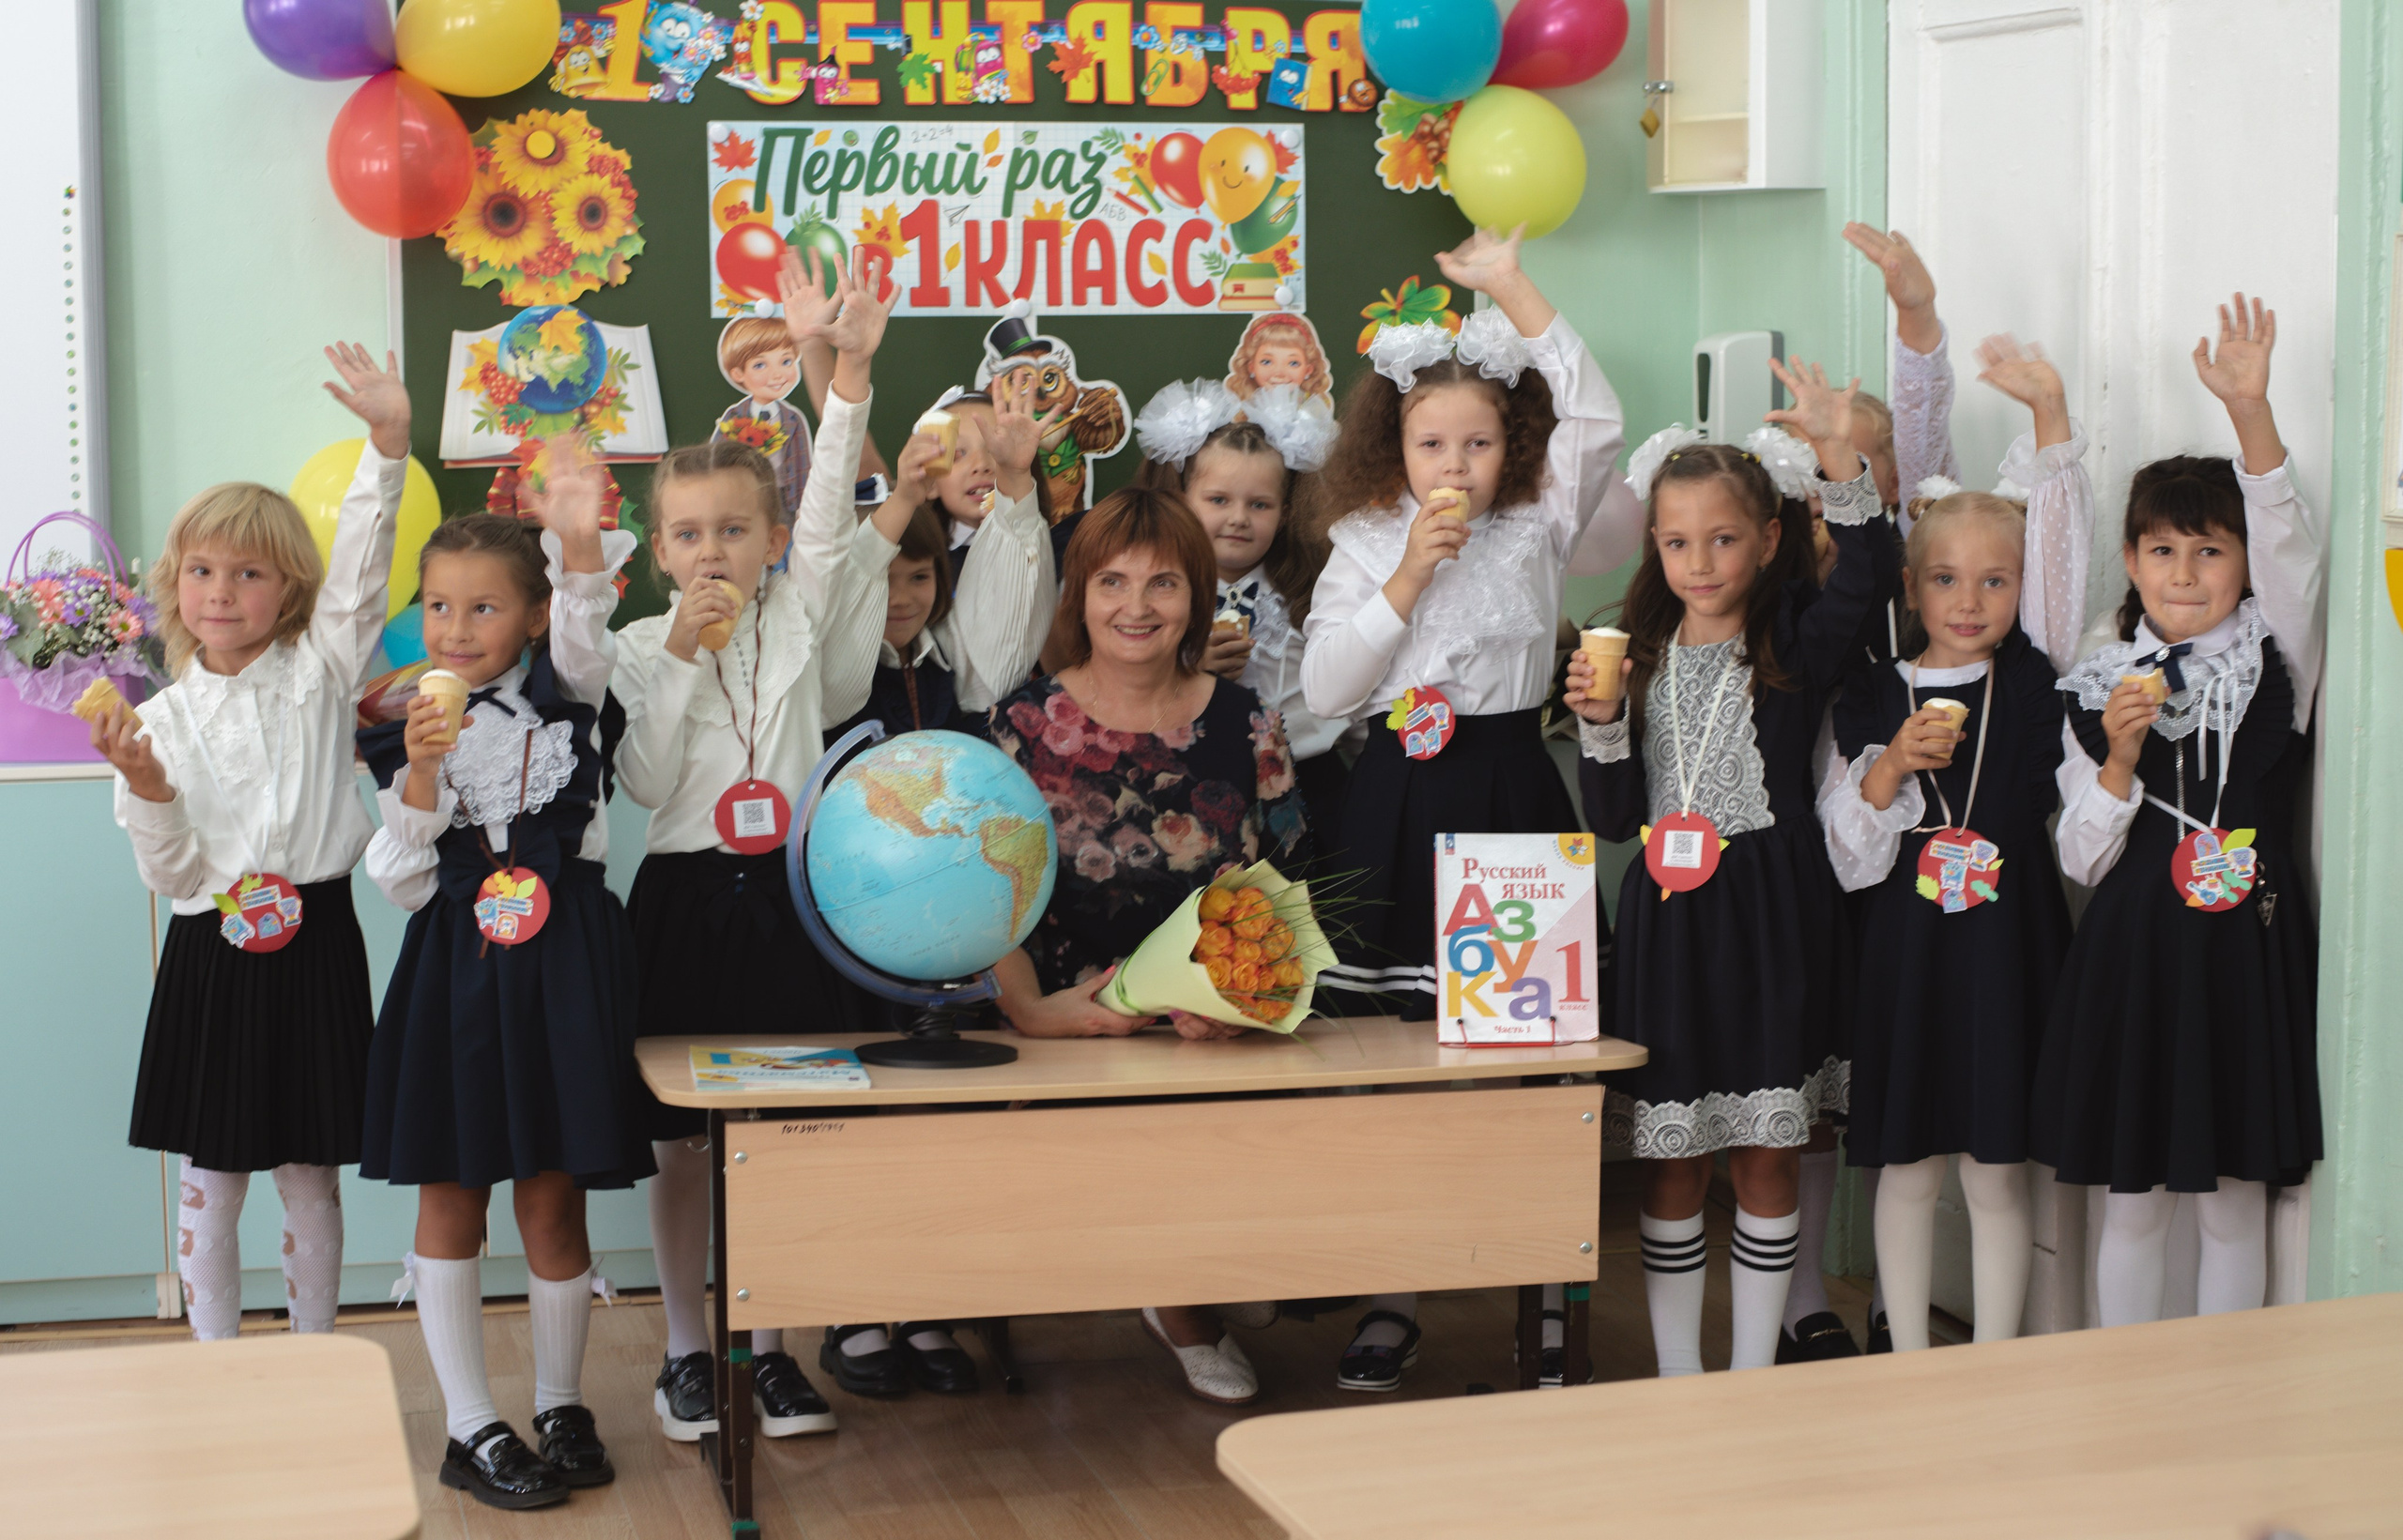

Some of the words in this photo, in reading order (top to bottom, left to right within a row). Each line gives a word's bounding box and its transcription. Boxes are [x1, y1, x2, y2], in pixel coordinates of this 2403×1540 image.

[582, 0, 651, 102] 1
[742, 0, 1376, 112] СЕНТЯБРЯ
[753, 125, 988, 220] Первый
[1001, 141, 1108, 220] раз
[900, 200, 951, 308] 1
[964, 219, 1216, 308] КЛАСС
[1462, 858, 1547, 883] Русский
[1555, 940, 1590, 1002] 1
